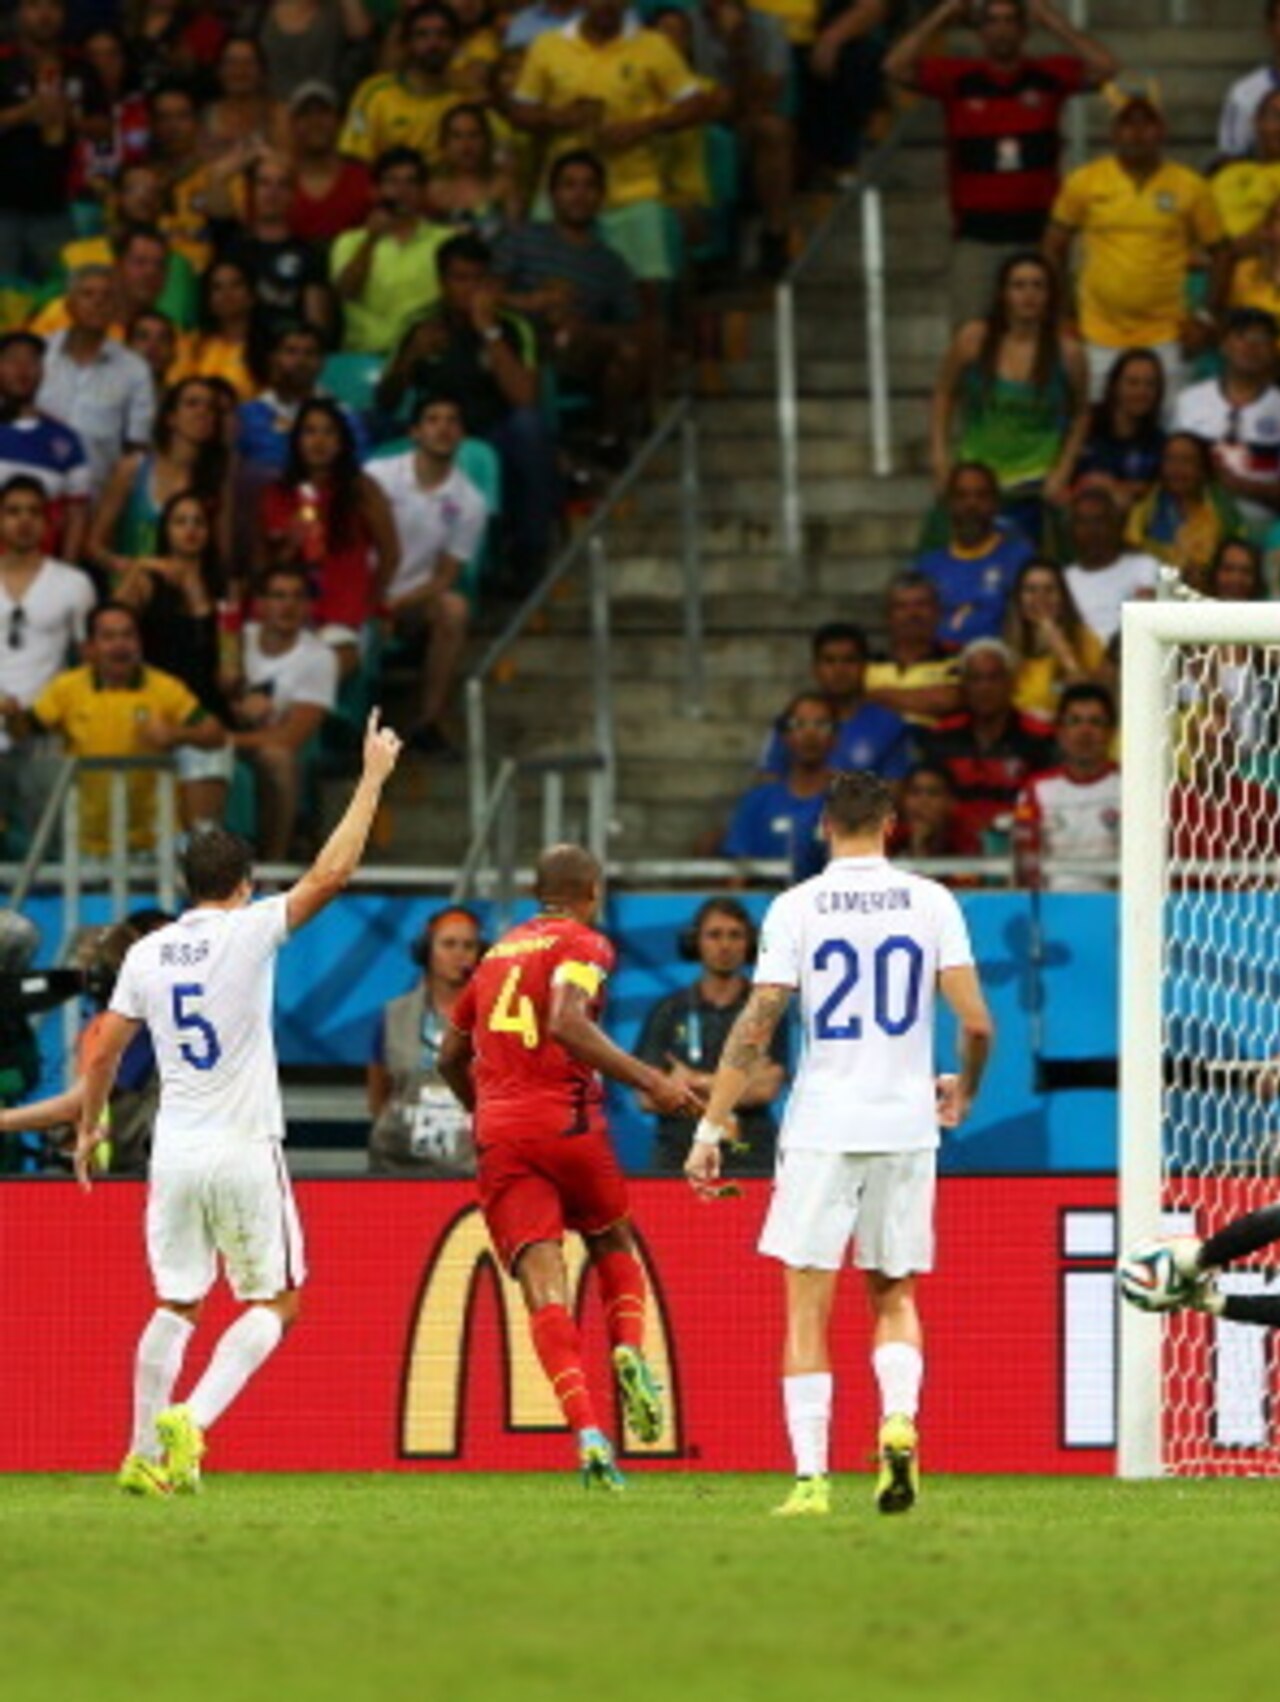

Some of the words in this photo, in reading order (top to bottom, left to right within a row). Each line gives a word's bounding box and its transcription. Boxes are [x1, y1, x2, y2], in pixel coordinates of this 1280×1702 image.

[172, 983, 222, 1071] 5
[489, 964, 539, 1049] 4
[813, 935, 924, 1040] 20
